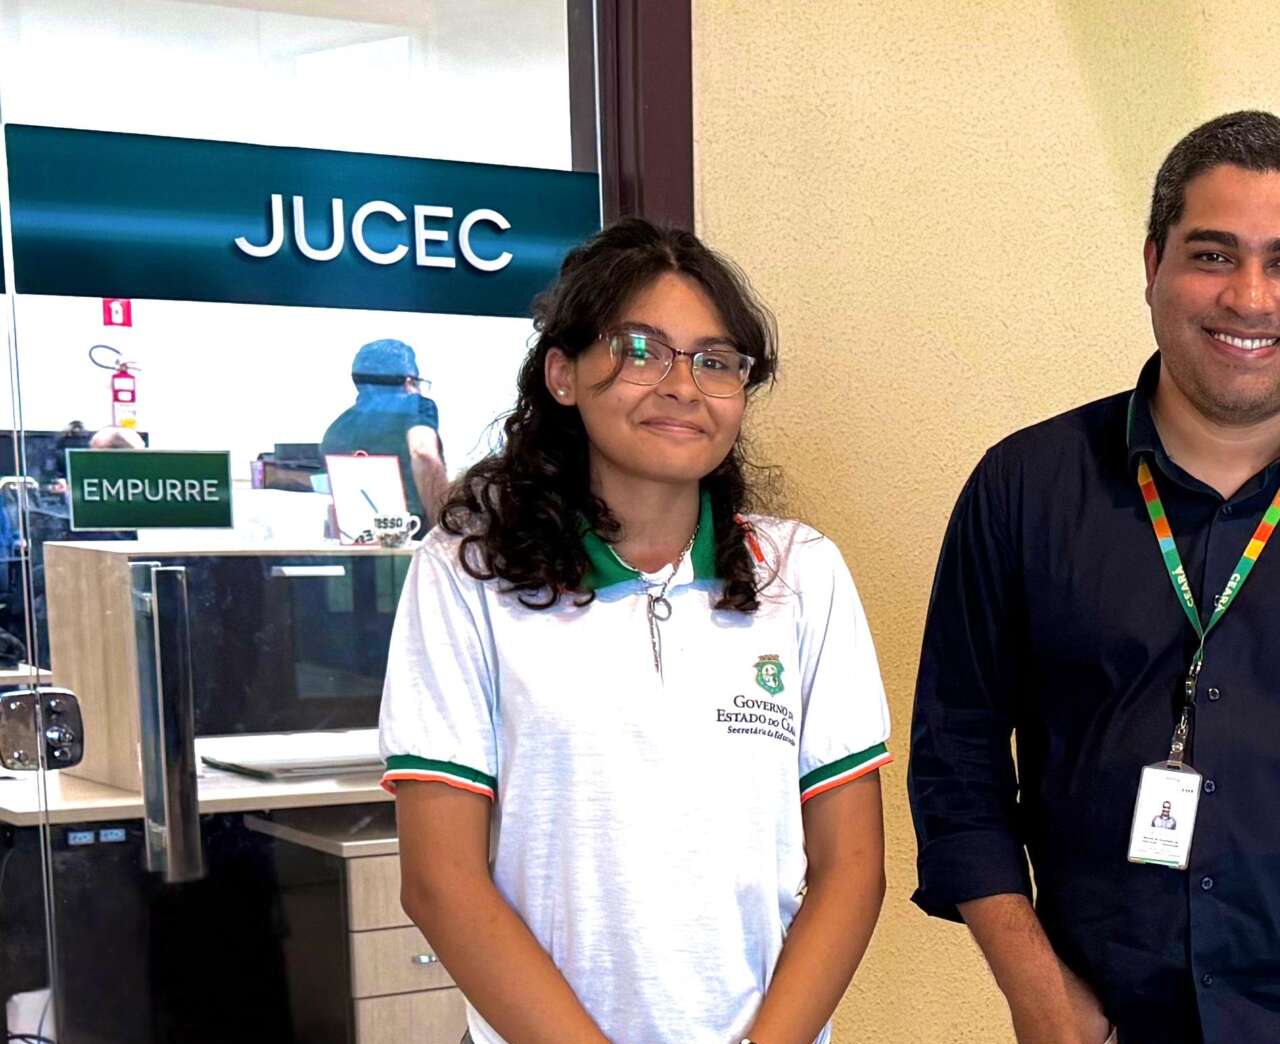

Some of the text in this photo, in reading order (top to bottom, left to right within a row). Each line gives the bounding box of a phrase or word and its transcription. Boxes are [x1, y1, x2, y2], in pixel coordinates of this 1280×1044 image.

[235, 194, 513, 272] JUCEC
[83, 479, 219, 501] EMPURRE
[1171, 565, 1194, 607] CEARÁ
[716, 708, 767, 724] ESTADO
[733, 694, 788, 717] GOVERNO
